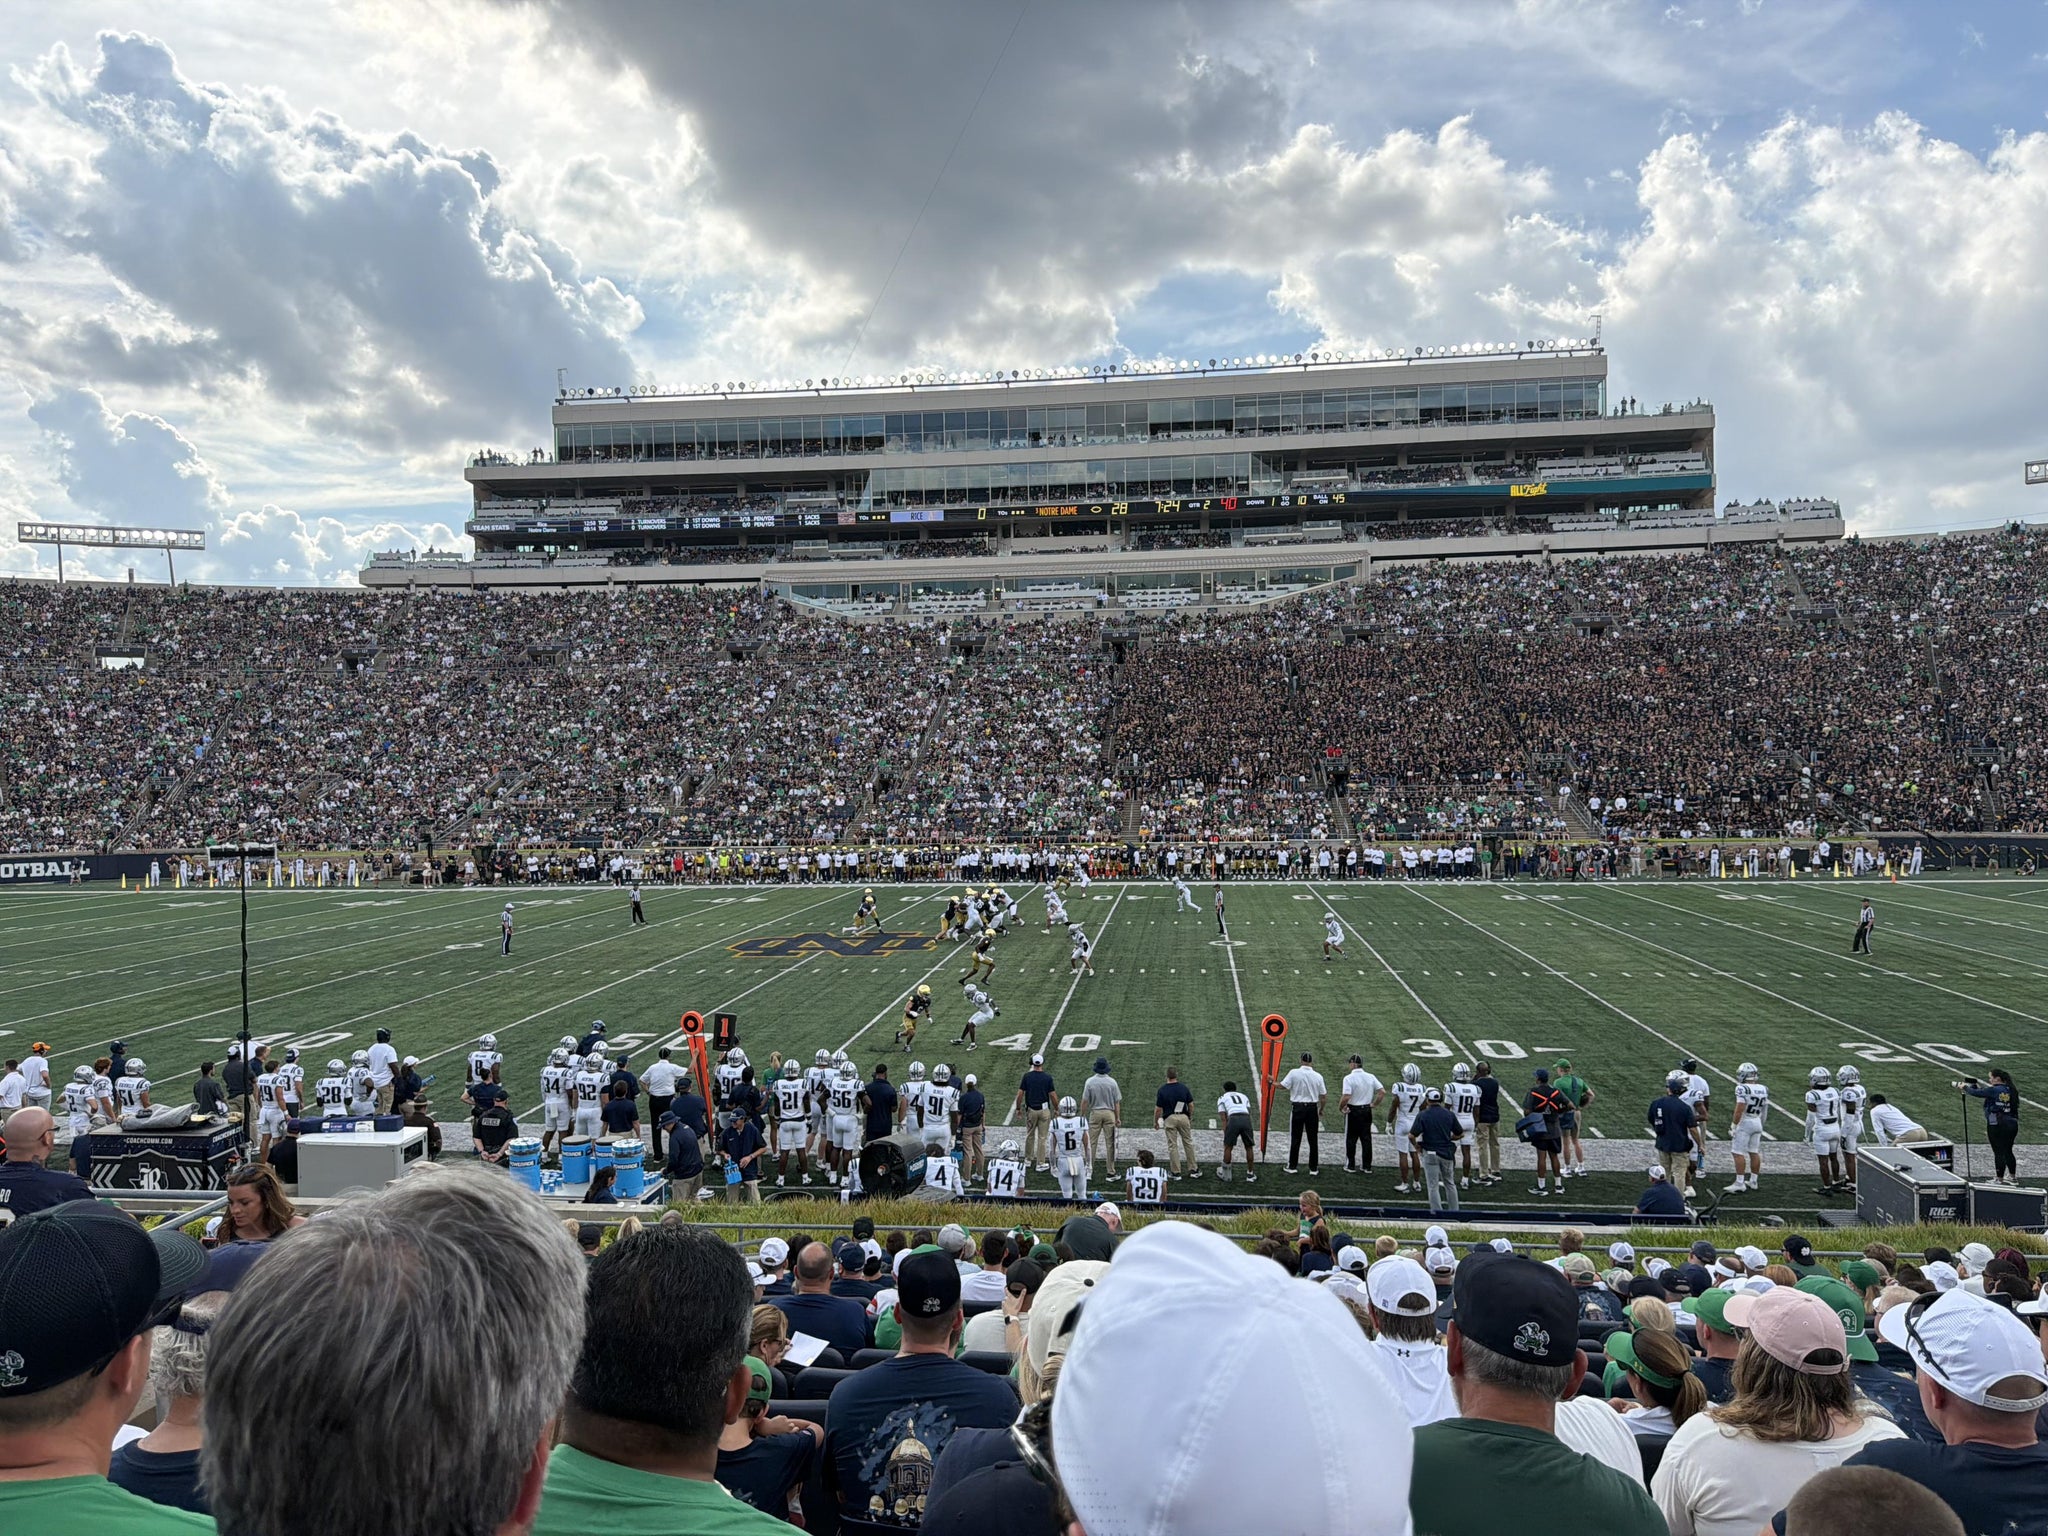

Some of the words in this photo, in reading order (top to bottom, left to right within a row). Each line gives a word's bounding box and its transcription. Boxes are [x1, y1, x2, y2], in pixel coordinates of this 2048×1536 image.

[1332, 493, 1345, 504] 45
[1510, 484, 1525, 496] ALL
[1111, 502, 1128, 514] 28
[1155, 500, 1180, 513] 7:24
[1203, 500, 1210, 510] 2
[1220, 497, 1237, 510] 40
[1297, 495, 1307, 505] 10
[910, 512, 923, 521] RICE
[978, 508, 986, 520] 0
[1039, 506, 1059, 516] NOTRE
[1060, 505, 1078, 515] DAME
[0, 860, 90, 878] OTBALL
[720, 1017, 729, 1038] 1
[987, 1033, 1102, 1052] 40
[1401, 1038, 1529, 1059] 30
[1838, 1042, 1991, 1063] 20
[475, 1059, 483, 1077] 8
[544, 1076, 560, 1094] 34
[578, 1083, 597, 1101] 92
[68, 1095, 78, 1112] 2
[118, 1090, 135, 1106] 51
[321, 1086, 342, 1104] 28
[782, 1091, 798, 1110] 21
[833, 1089, 851, 1108] 56
[1408, 1095, 1419, 1113] 7
[1458, 1095, 1473, 1113] 18
[928, 1096, 943, 1117] 91
[1829, 1100, 1833, 1116] 1
[483, 1118, 499, 1126] POLICE
[1064, 1131, 1077, 1151] 6
[935, 1165, 947, 1187] 4
[994, 1168, 1014, 1192] 14
[1135, 1177, 1158, 1200] 29
[1928, 1207, 1957, 1217] RICE
